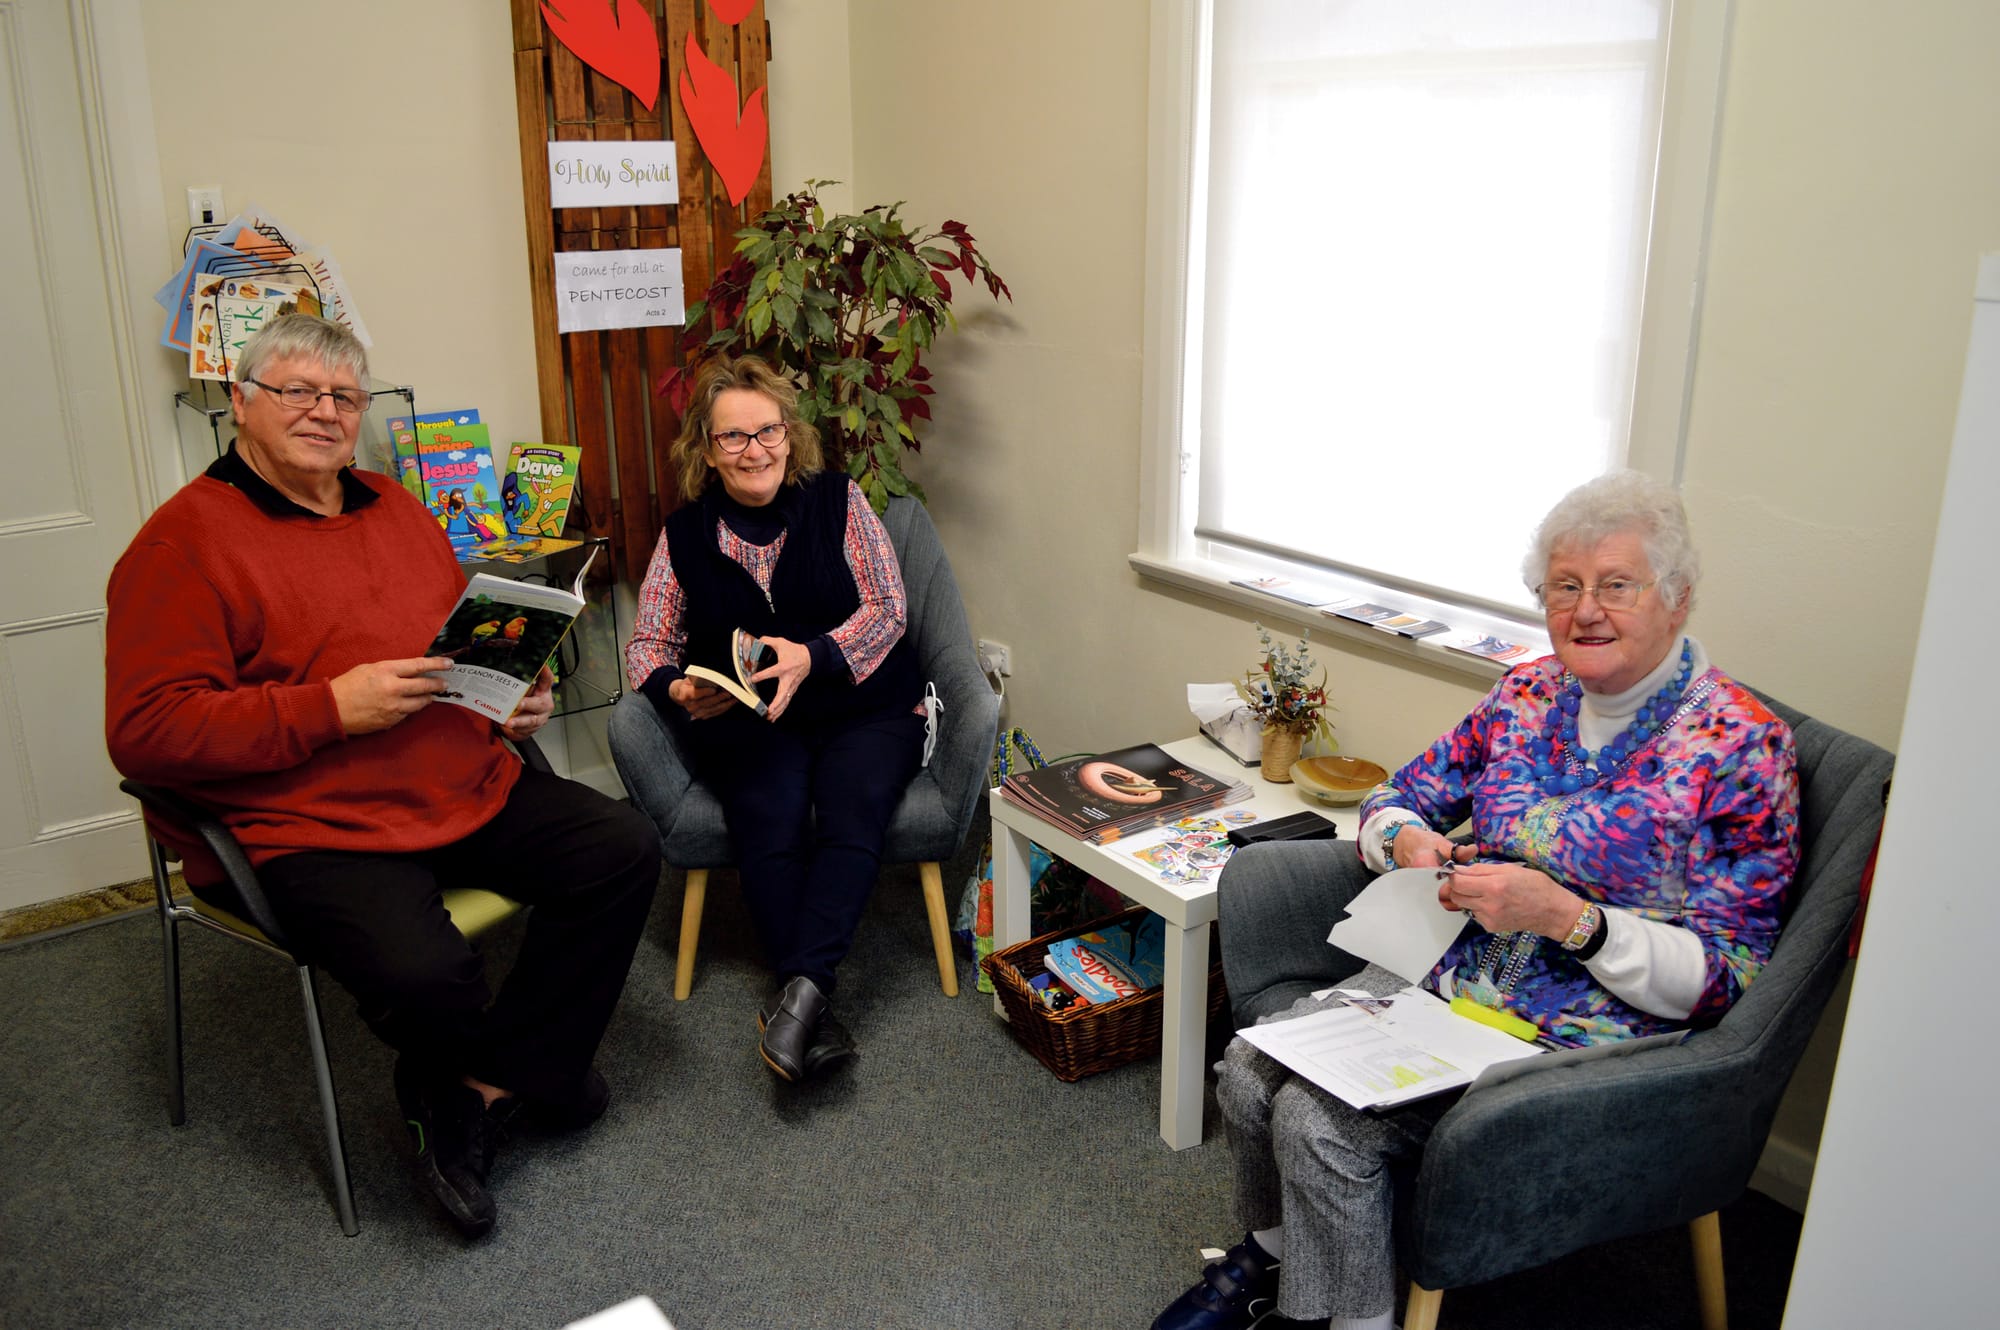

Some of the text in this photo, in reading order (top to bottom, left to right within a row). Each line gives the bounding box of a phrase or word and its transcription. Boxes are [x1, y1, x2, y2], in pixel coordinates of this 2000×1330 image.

[554, 158, 672, 190] Holy Spirit
[572, 261, 665, 279] came for all at
[568, 286, 673, 303] PENTECOST
[645, 308, 667, 317] Acts 2
[217, 306, 233, 350] Noah's
[415, 417, 456, 431] Through
[433, 433, 452, 443] The
[421, 461, 479, 482] Jesus
[516, 456, 564, 478] Dave
[467, 668, 495, 680] CANON
[494, 675, 511, 686] SEES
[474, 699, 502, 715] Canon
